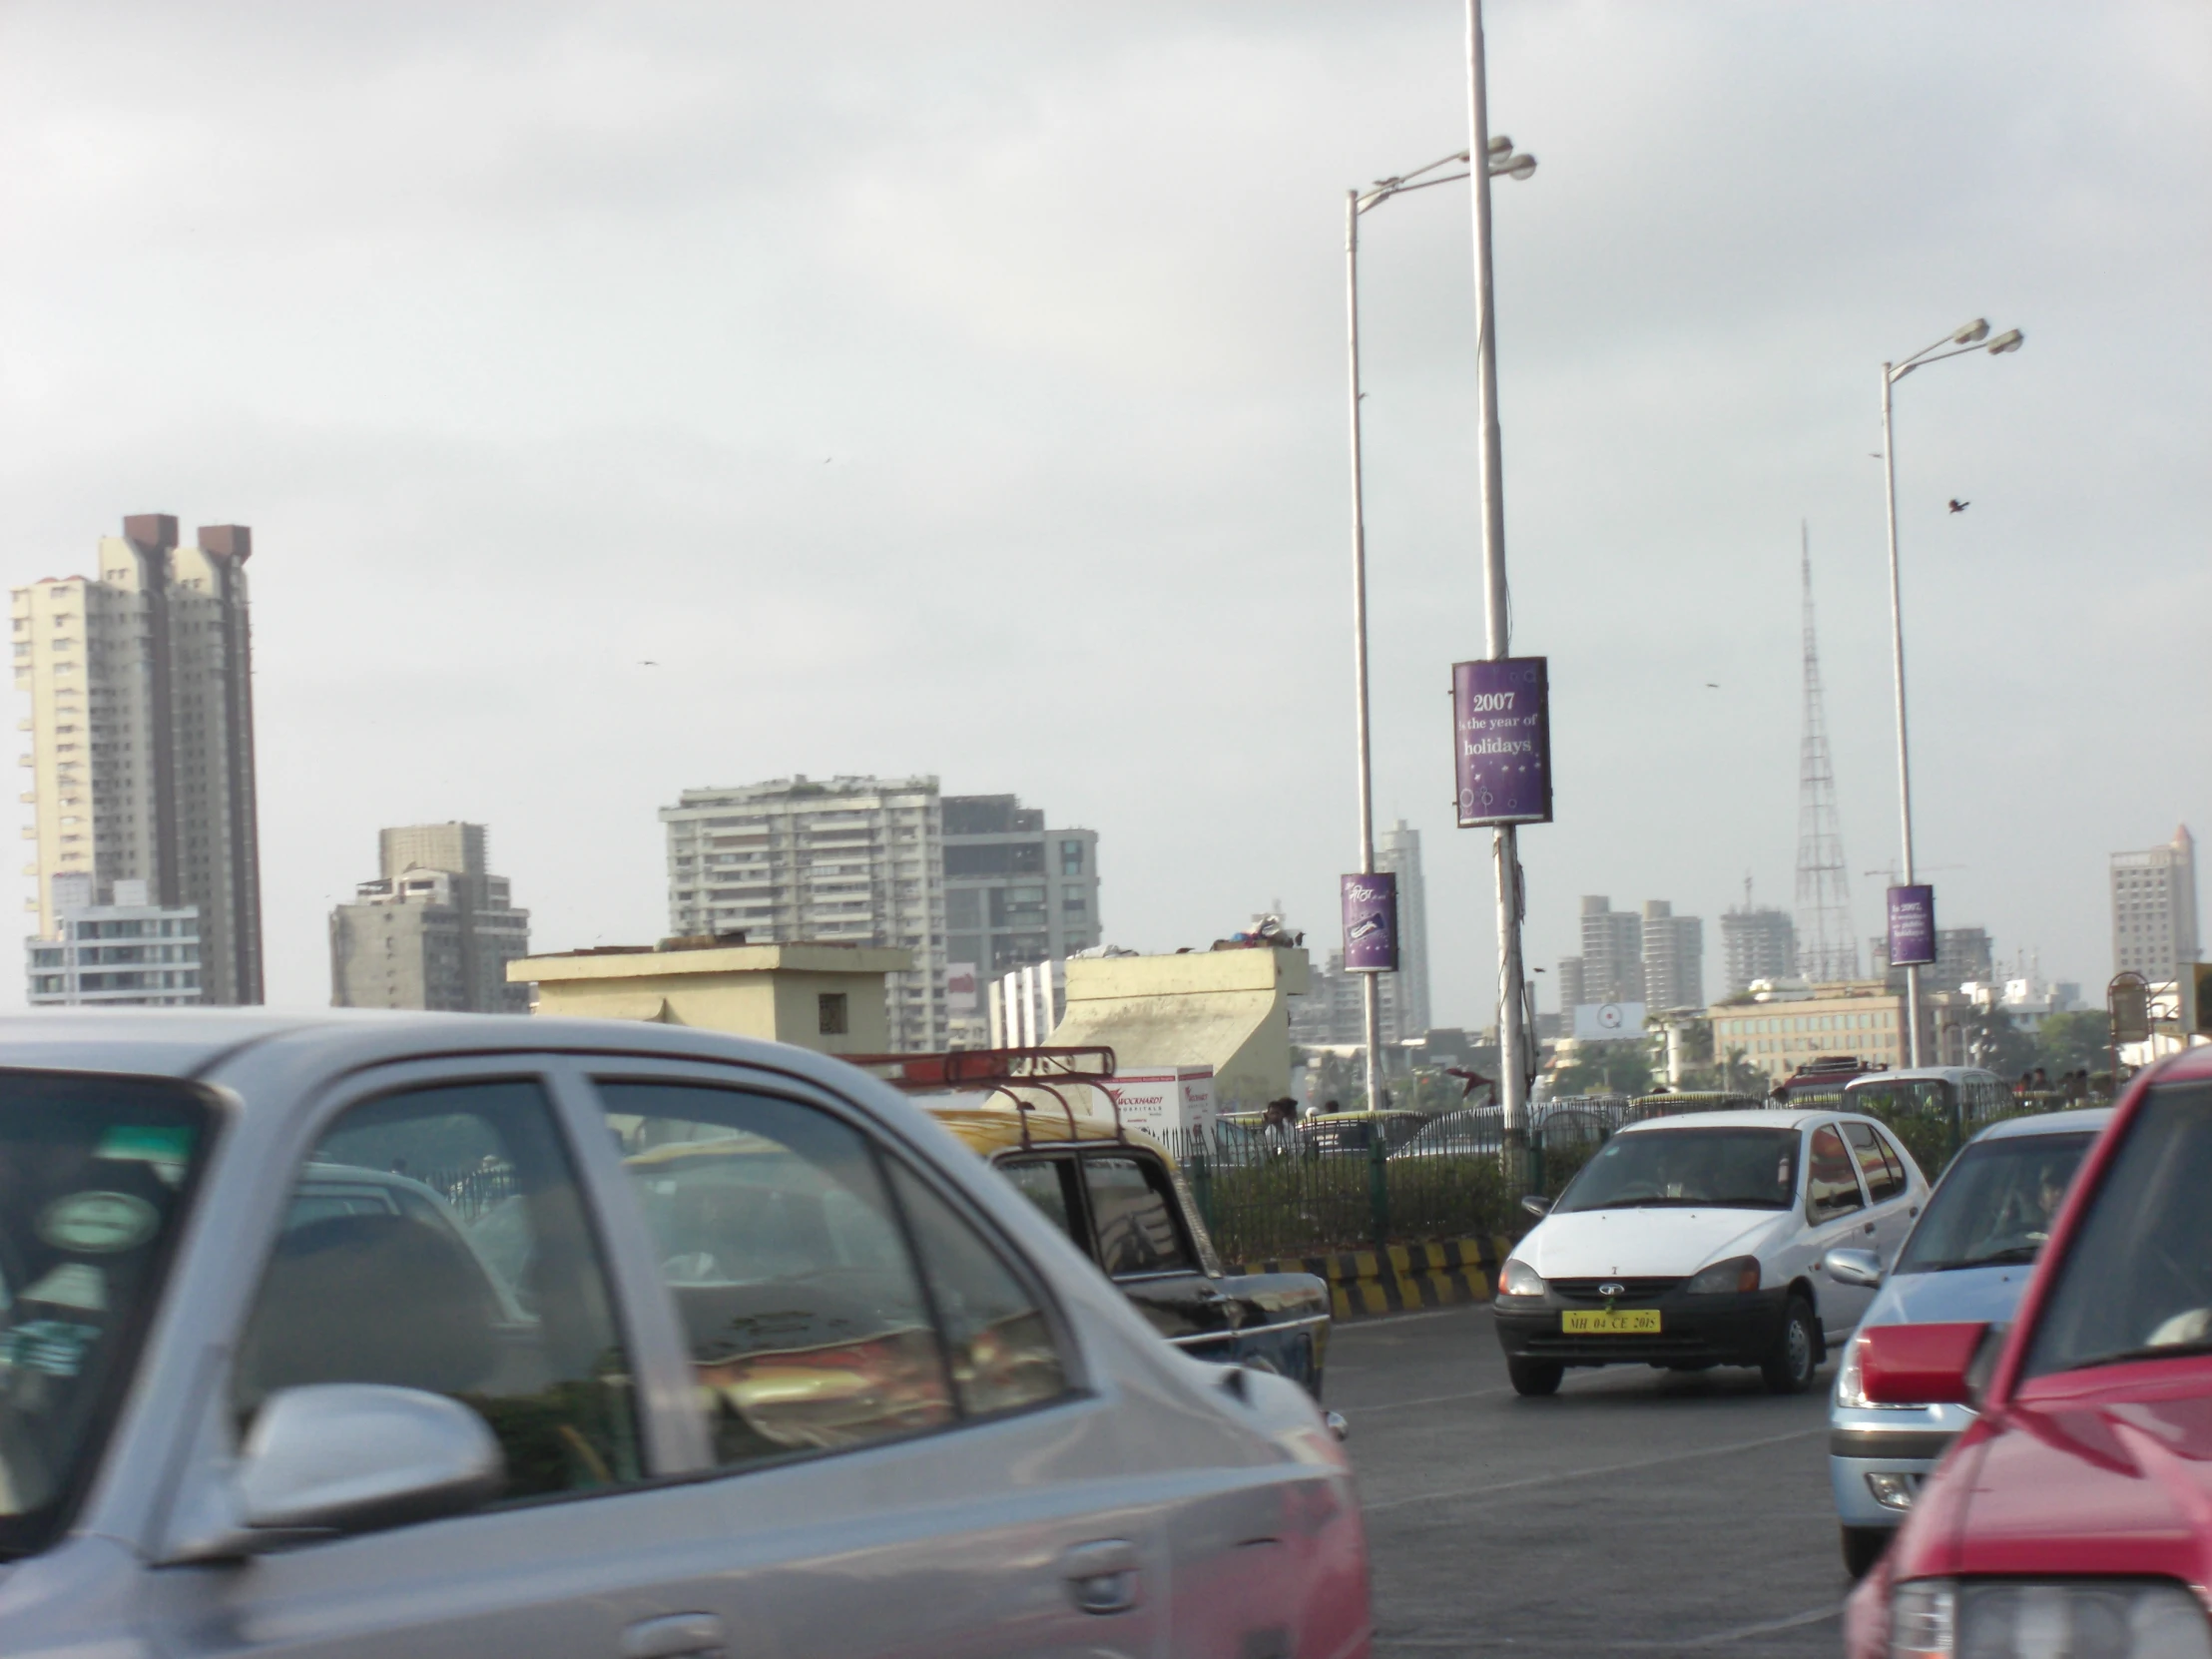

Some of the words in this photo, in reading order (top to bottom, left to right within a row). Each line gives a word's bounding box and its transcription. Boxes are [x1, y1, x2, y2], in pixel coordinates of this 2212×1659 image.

[1473, 692, 1515, 712] 2007
[1467, 717, 1486, 730] the
[1489, 717, 1520, 731] year
[1523, 713, 1538, 727] of
[1118, 1096, 1163, 1105] WOCKHARDT
[1570, 1318, 1588, 1330] MH
[1593, 1318, 1606, 1329] 04
[1611, 1317, 1629, 1329] CE
[1633, 1317, 1656, 1329] 2015
